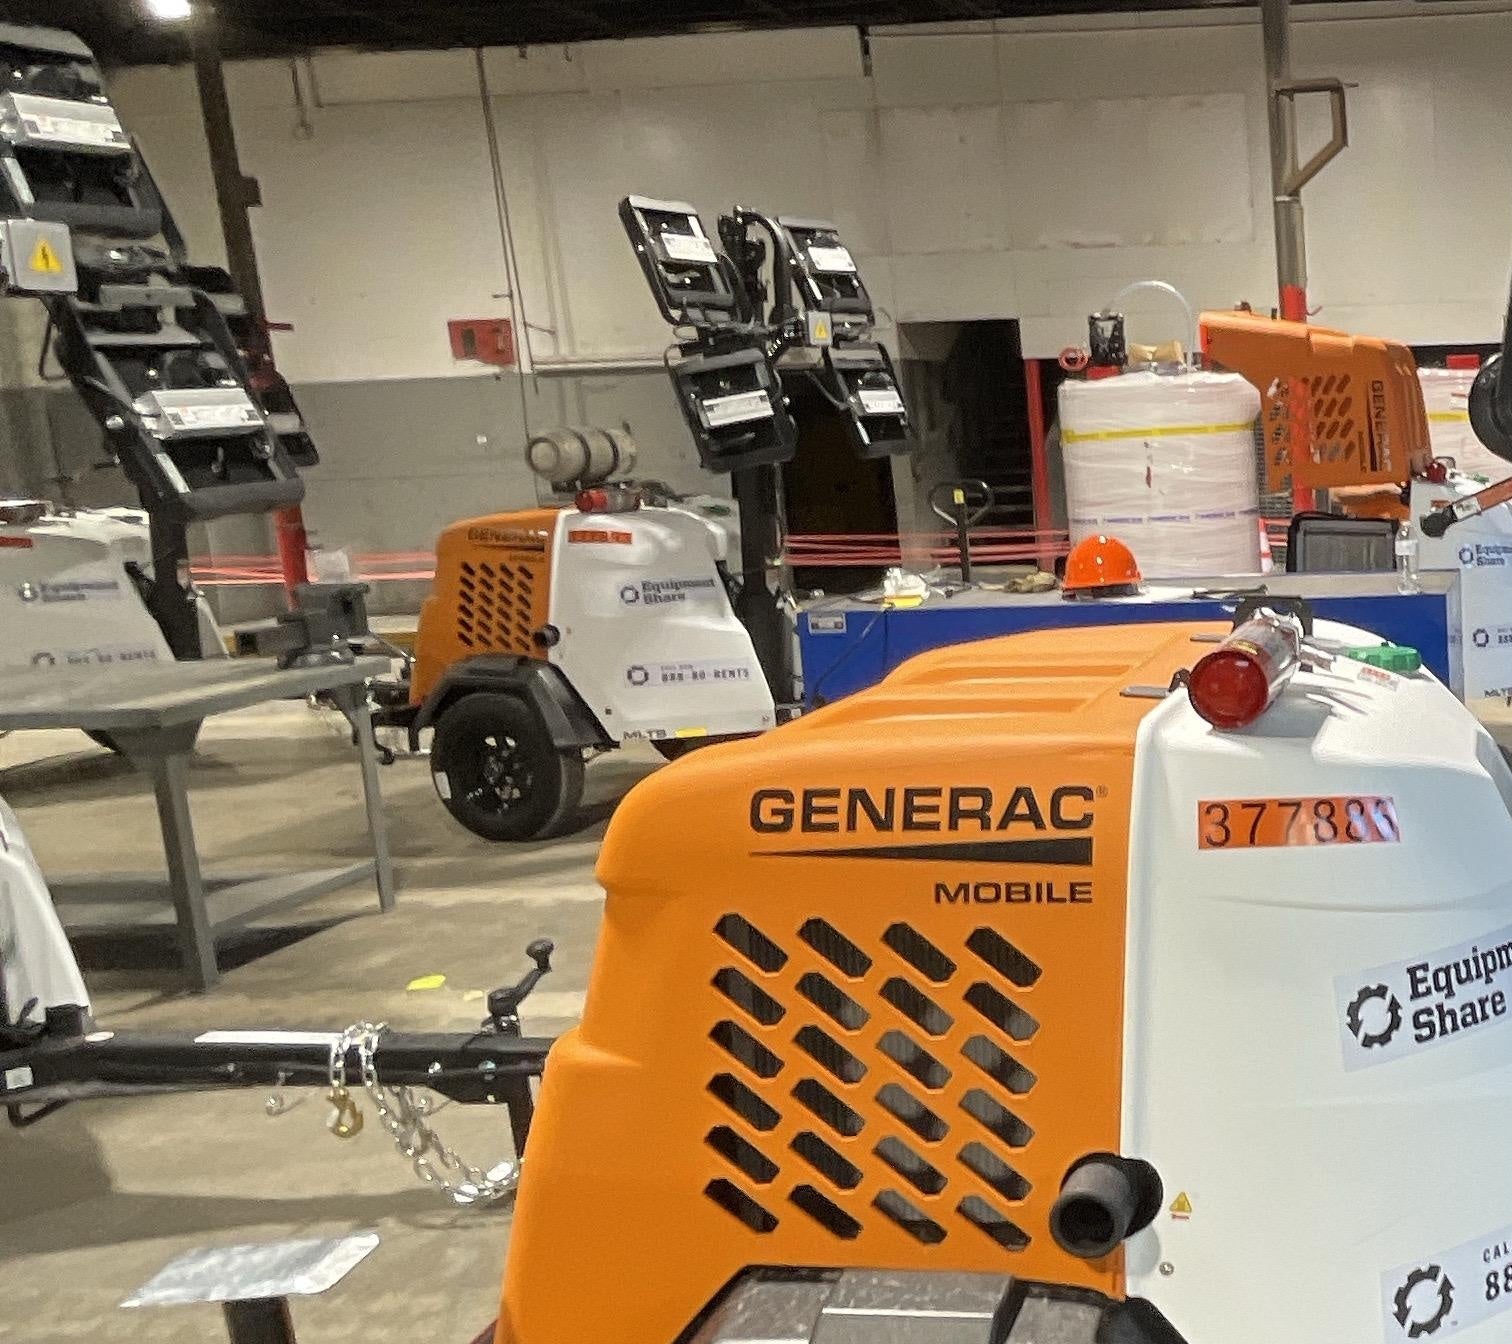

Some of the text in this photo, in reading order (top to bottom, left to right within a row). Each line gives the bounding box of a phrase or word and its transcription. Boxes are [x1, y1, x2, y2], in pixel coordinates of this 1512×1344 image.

[749, 786, 1095, 834] GENERAC
[934, 881, 1094, 906] MOBILE
[1412, 989, 1507, 1043] Share
